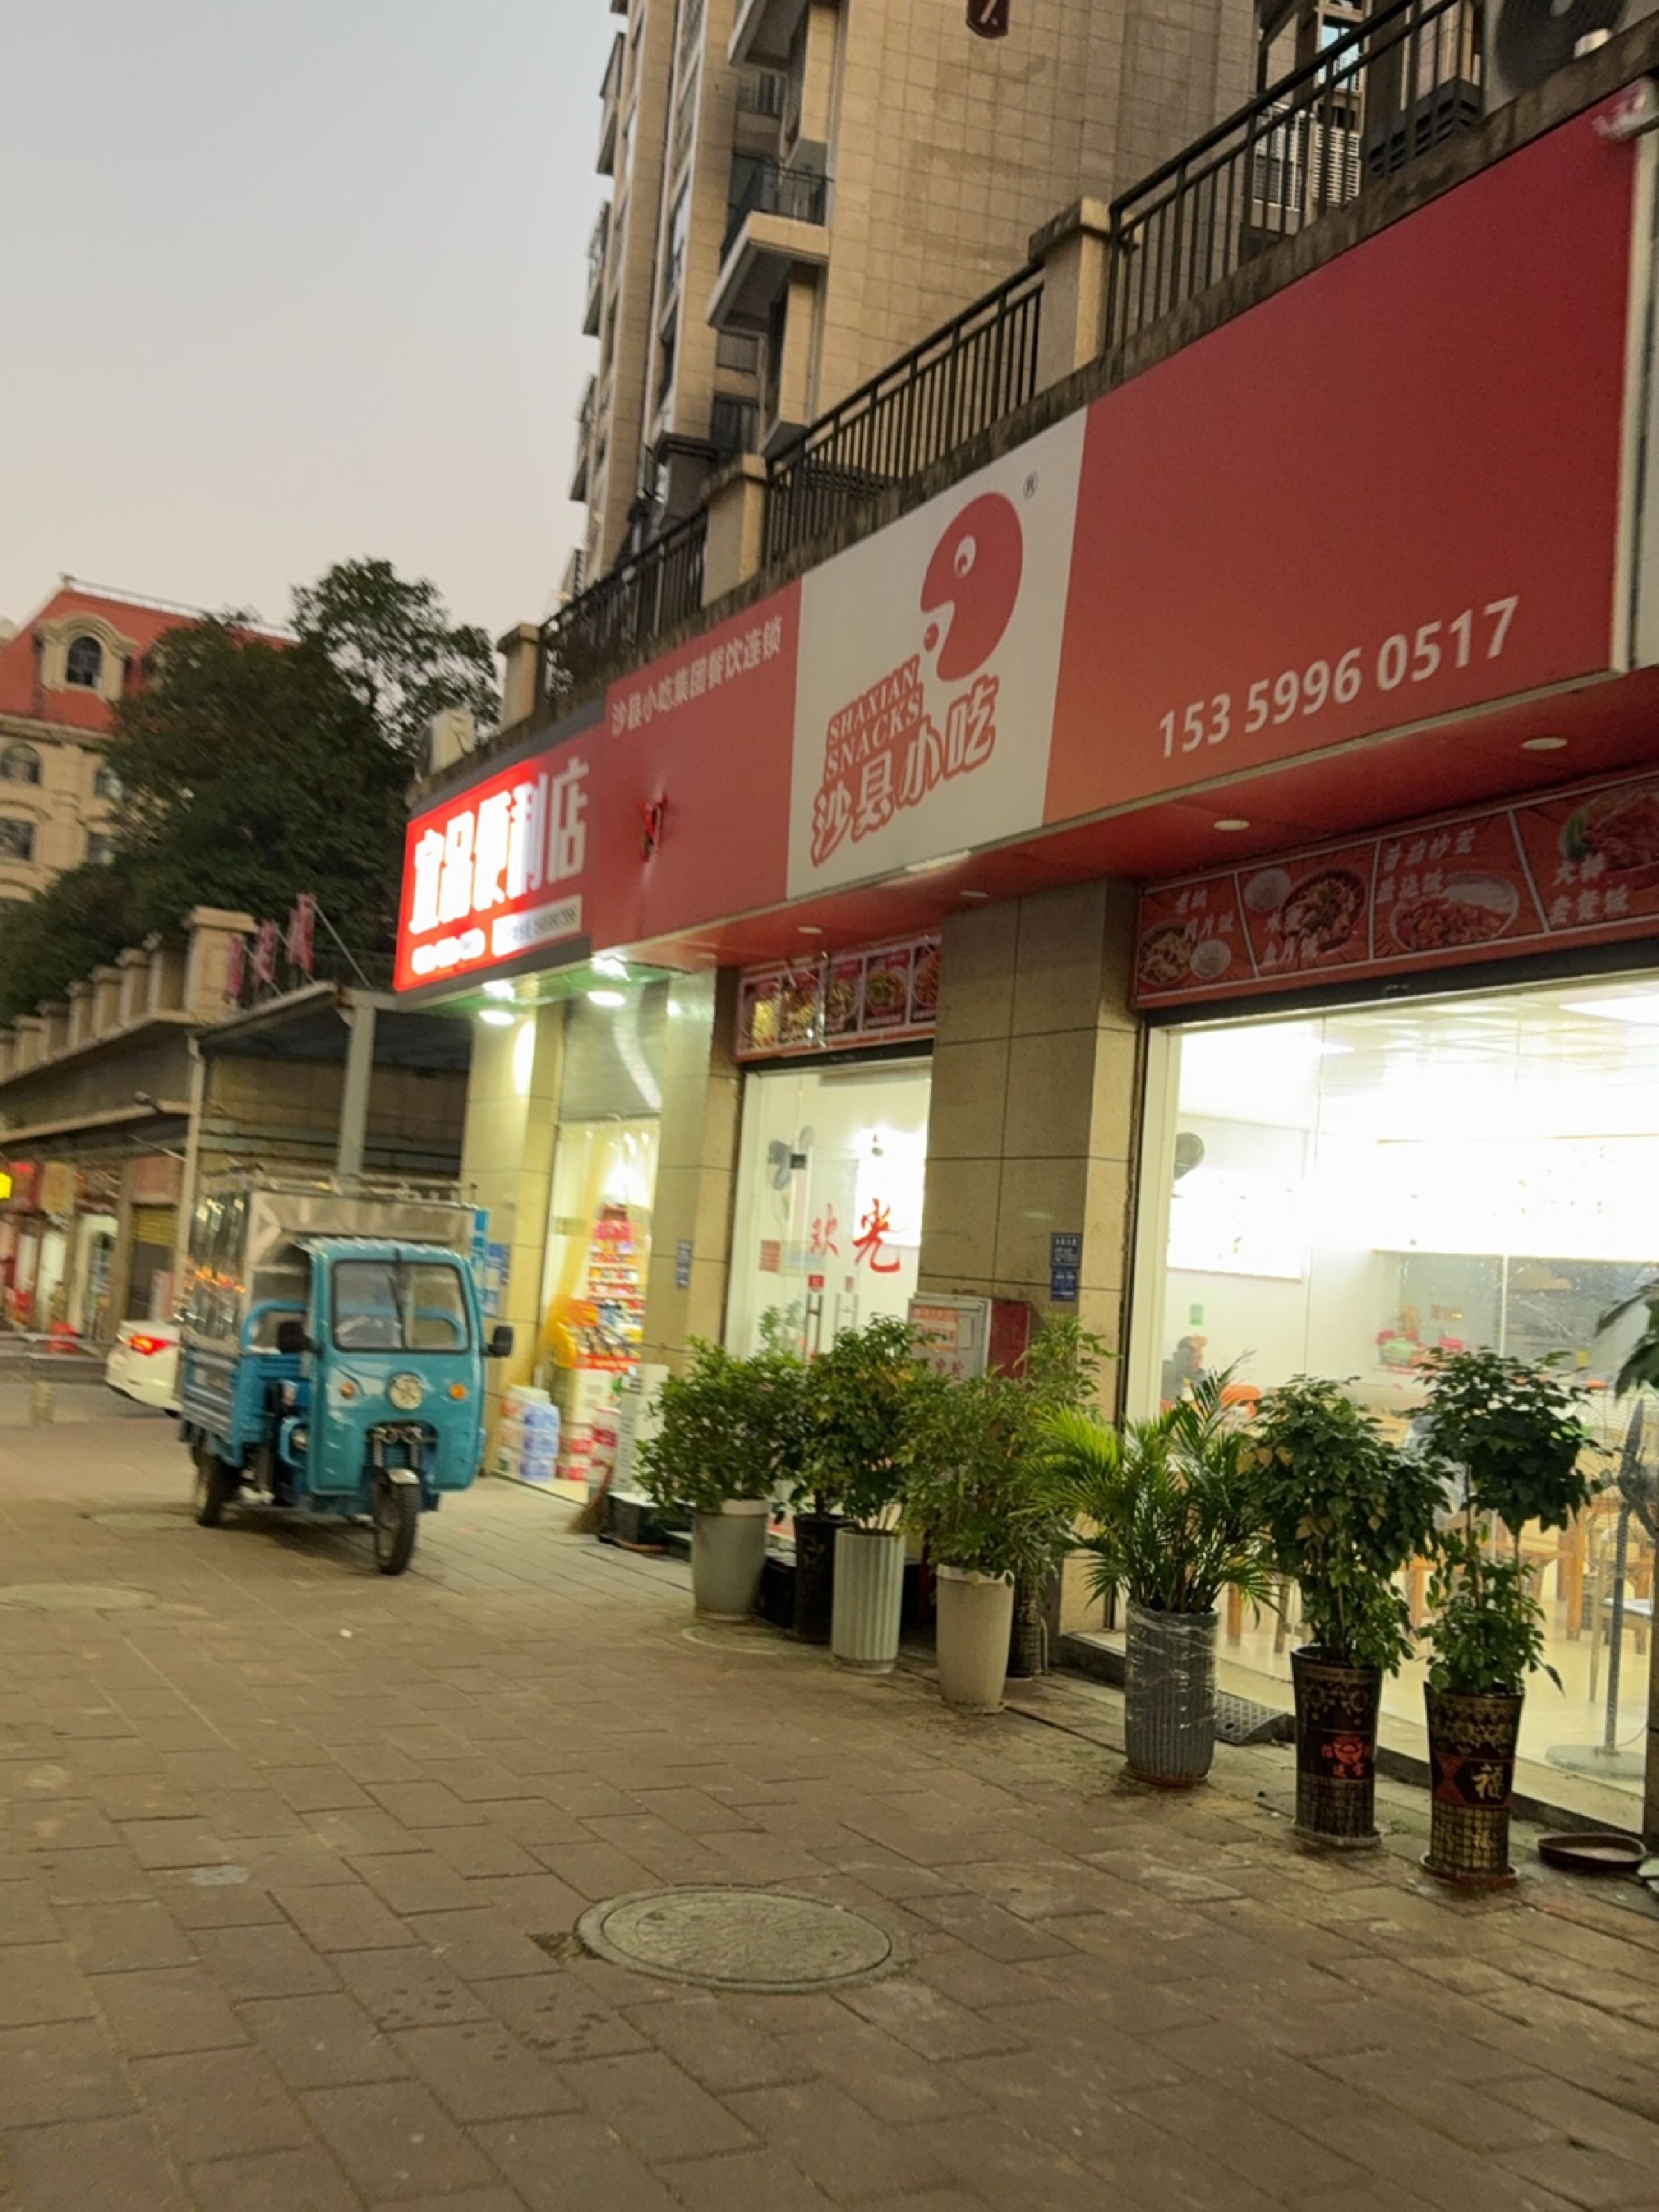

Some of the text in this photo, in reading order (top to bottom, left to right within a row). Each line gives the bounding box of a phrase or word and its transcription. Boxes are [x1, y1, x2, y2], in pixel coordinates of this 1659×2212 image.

[829, 662, 917, 742] SHAXIAN
[1159, 595, 1519, 758] 153 5996 0517
[811, 677, 998, 867] 沙县小吃
[825, 690, 921, 782] SNACKS
[853, 1198, 901, 1272] 光
